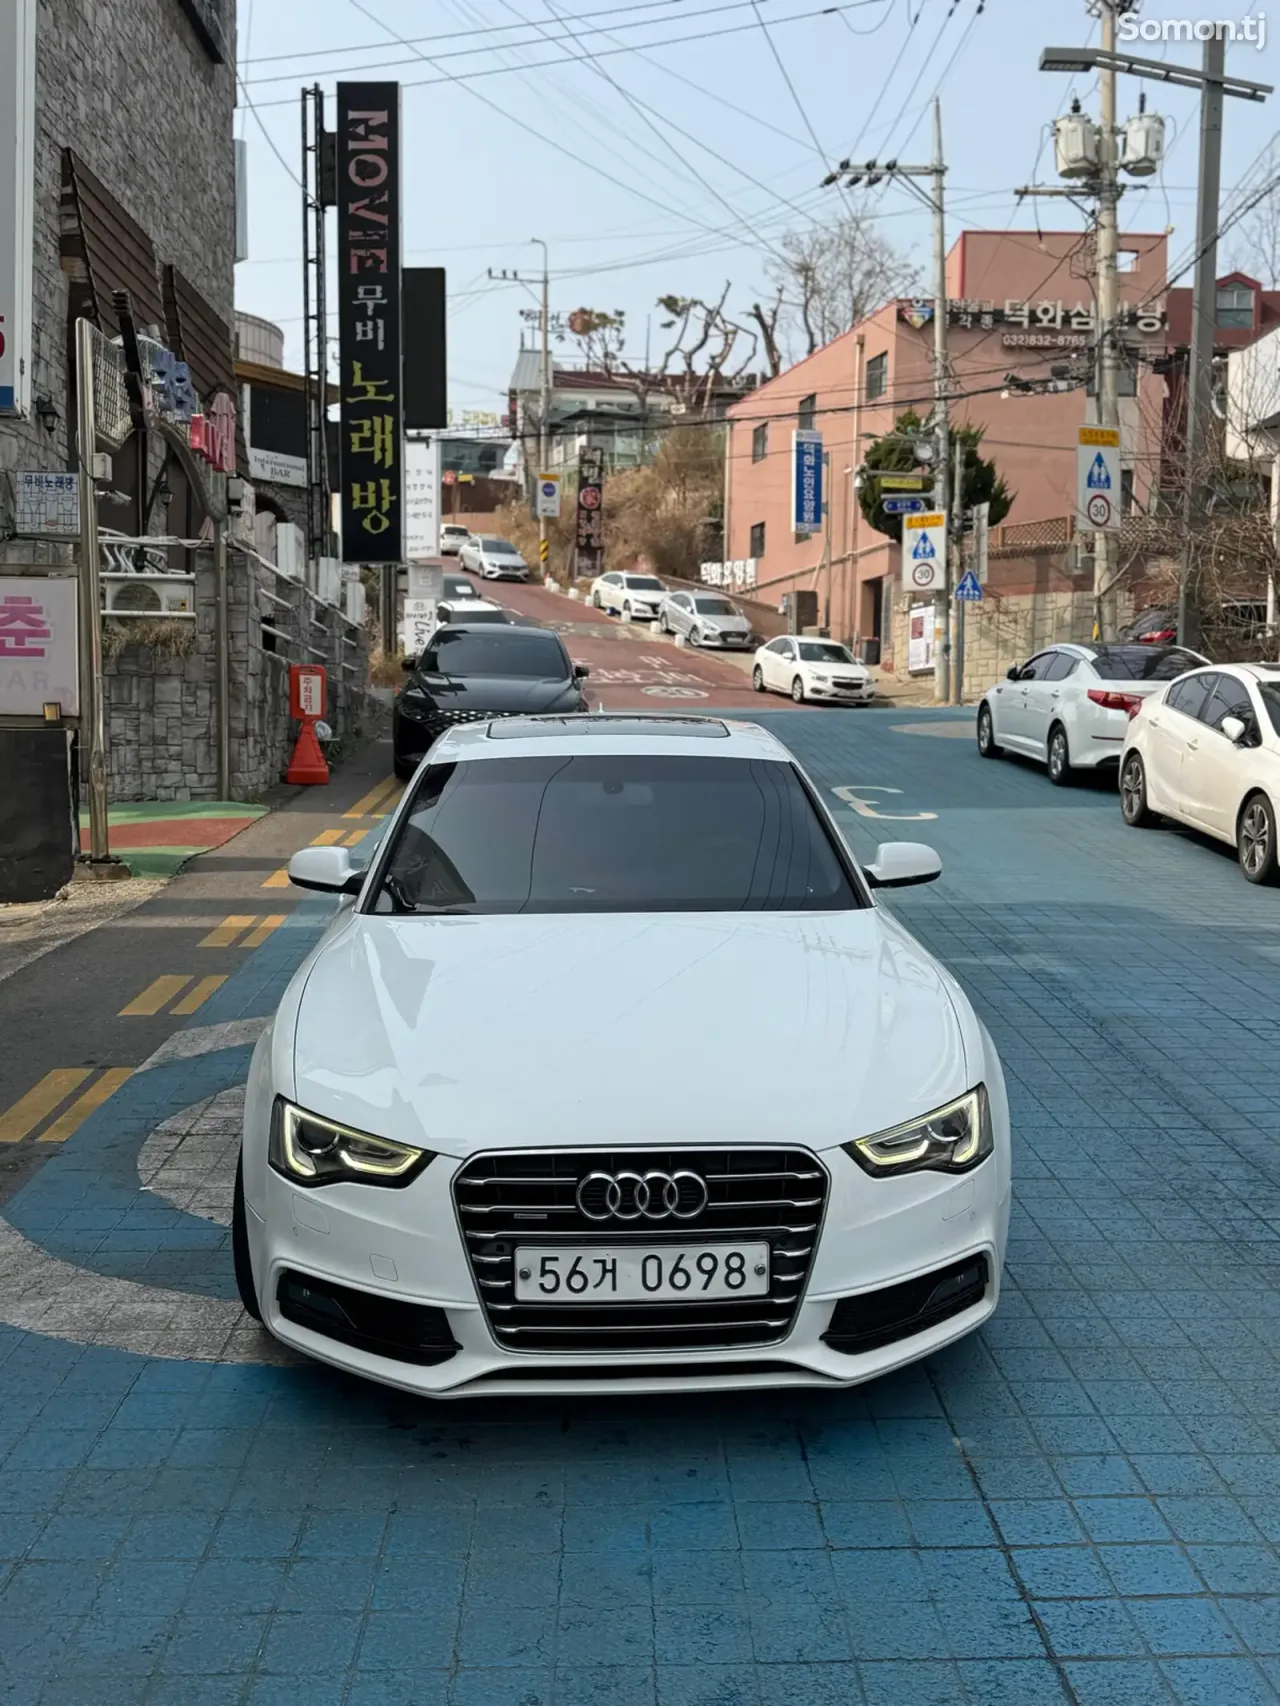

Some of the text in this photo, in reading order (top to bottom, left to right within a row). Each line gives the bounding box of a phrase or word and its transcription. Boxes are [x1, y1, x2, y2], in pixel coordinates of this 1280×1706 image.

[352, 285, 388, 350] 무비
[346, 360, 396, 534] 노래방
[270, 467, 291, 478] BAR
[1092, 503, 1106, 517] 30
[917, 569, 930, 580] 30
[0, 595, 51, 658] 춘
[538, 1251, 746, 1294] 56거 0698
